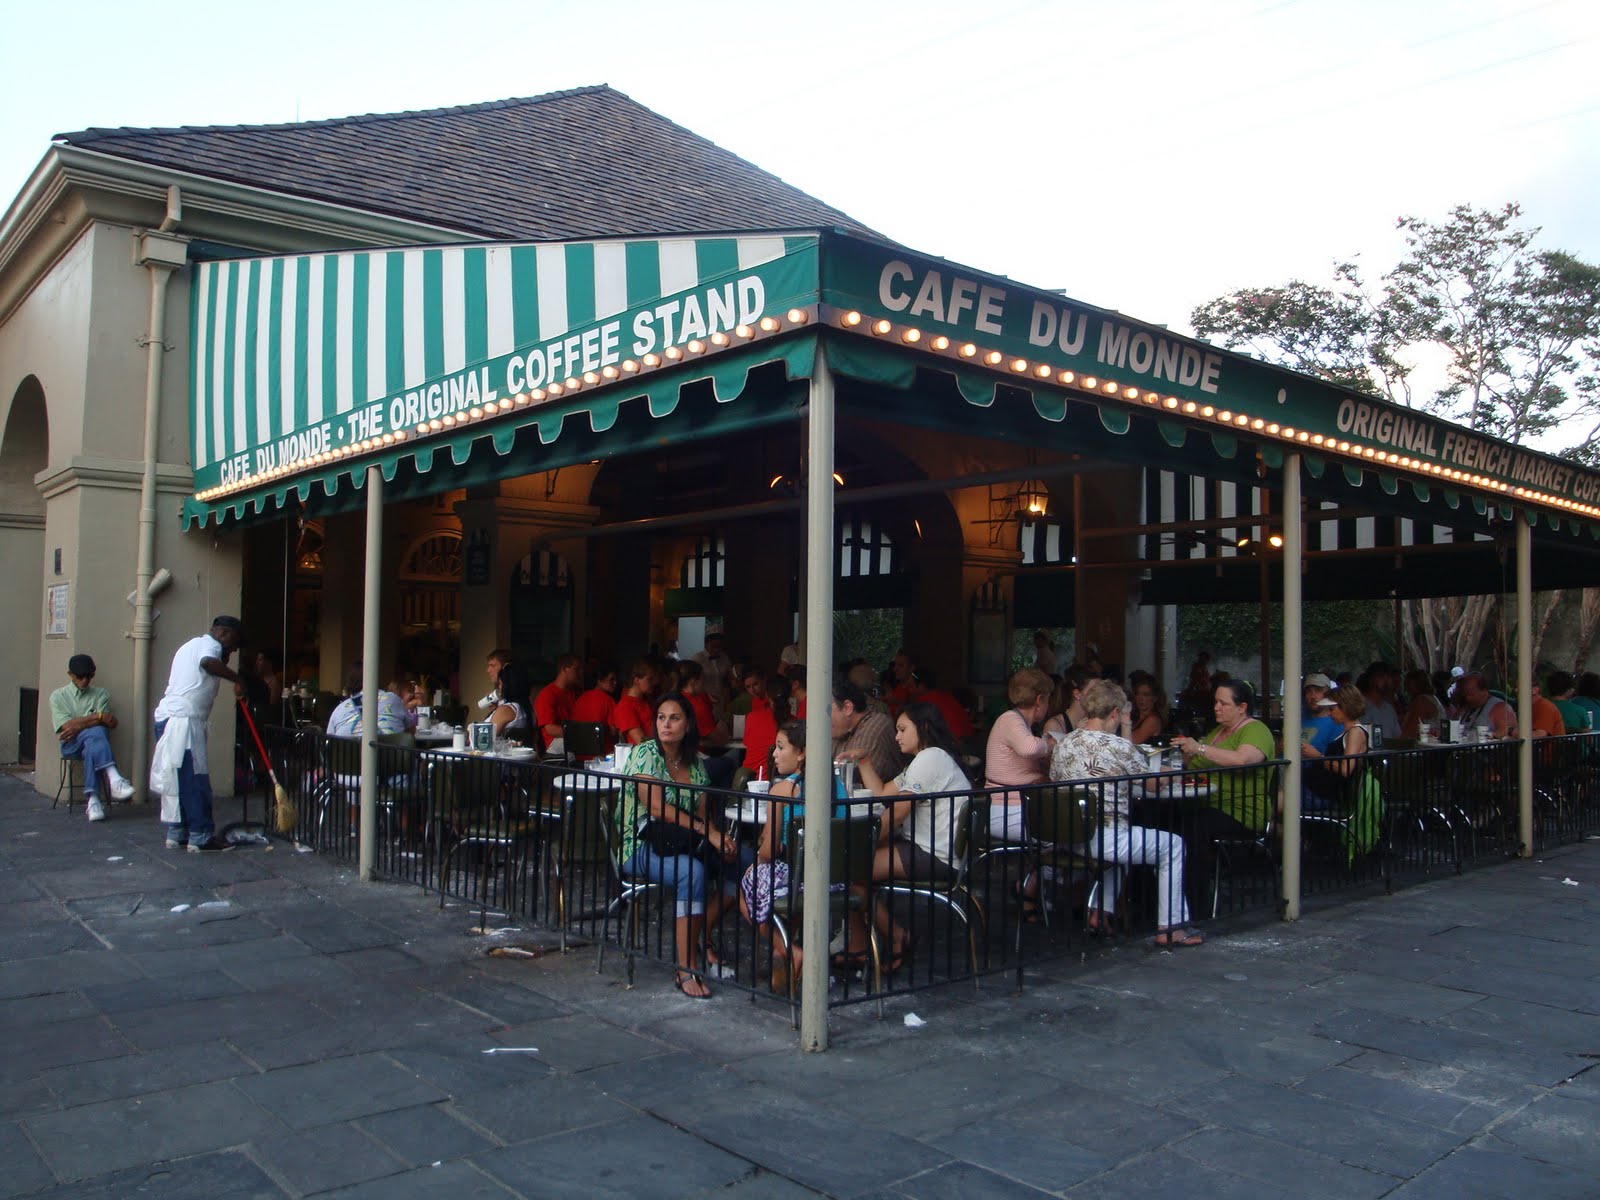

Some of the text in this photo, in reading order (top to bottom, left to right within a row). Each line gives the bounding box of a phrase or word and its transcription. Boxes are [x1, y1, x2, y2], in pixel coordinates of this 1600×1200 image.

[220, 275, 765, 486] CAFE DU MONDE THE ORIGINAL COFFEE STAND
[878, 260, 1006, 335] CAFE
[1029, 300, 1087, 356] DU
[1097, 322, 1223, 394] MONDE
[1336, 399, 1437, 458] ORIGINAL
[1441, 432, 1512, 477] FRENCH
[1511, 452, 1574, 493] MARKET
